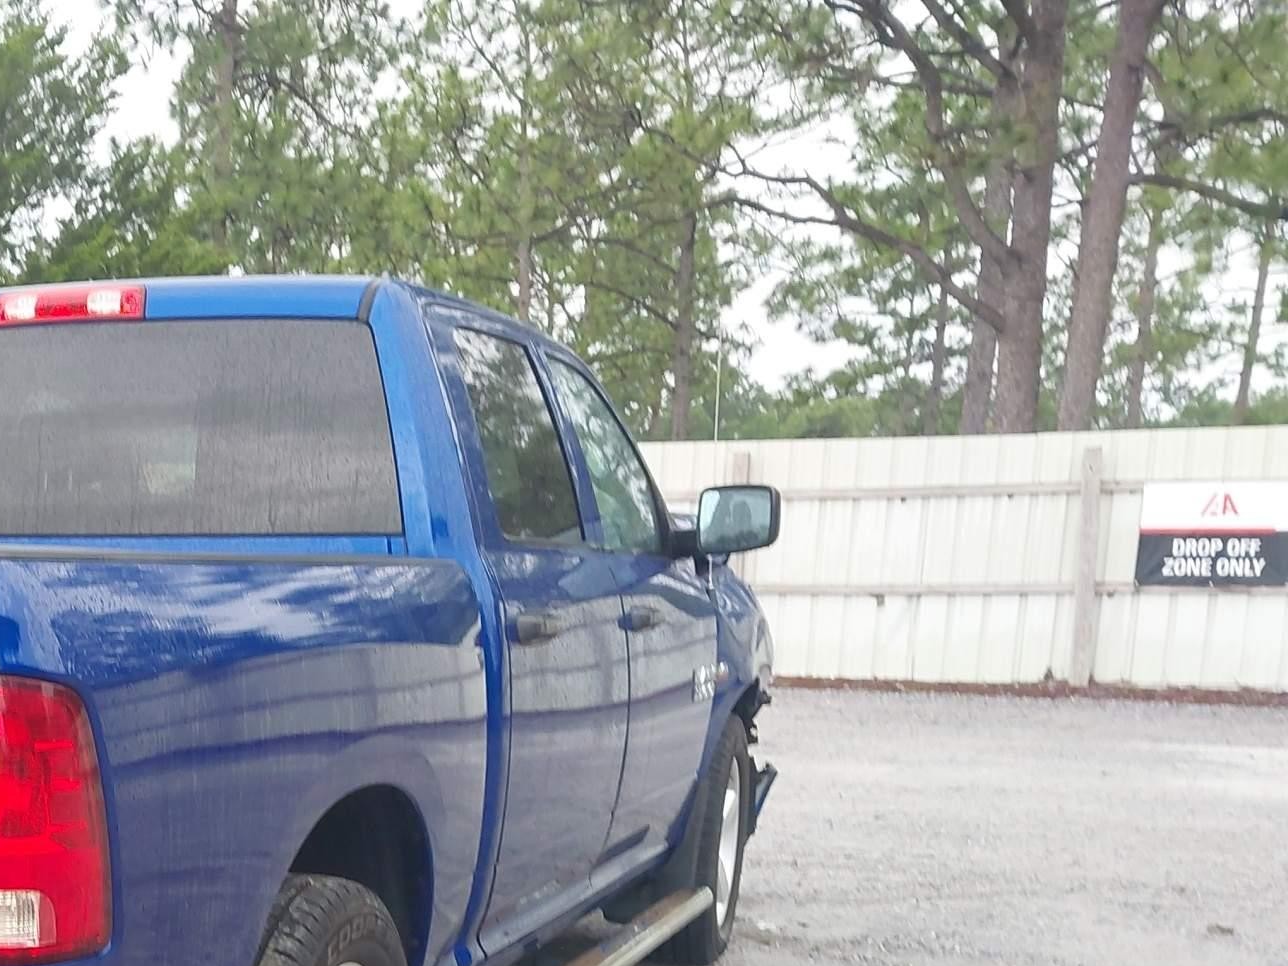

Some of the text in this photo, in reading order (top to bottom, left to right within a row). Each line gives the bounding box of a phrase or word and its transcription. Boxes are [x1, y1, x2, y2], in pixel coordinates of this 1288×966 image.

[1172, 538, 1261, 557] DROP OFF
[1162, 557, 1266, 577] ZONE ONLY
